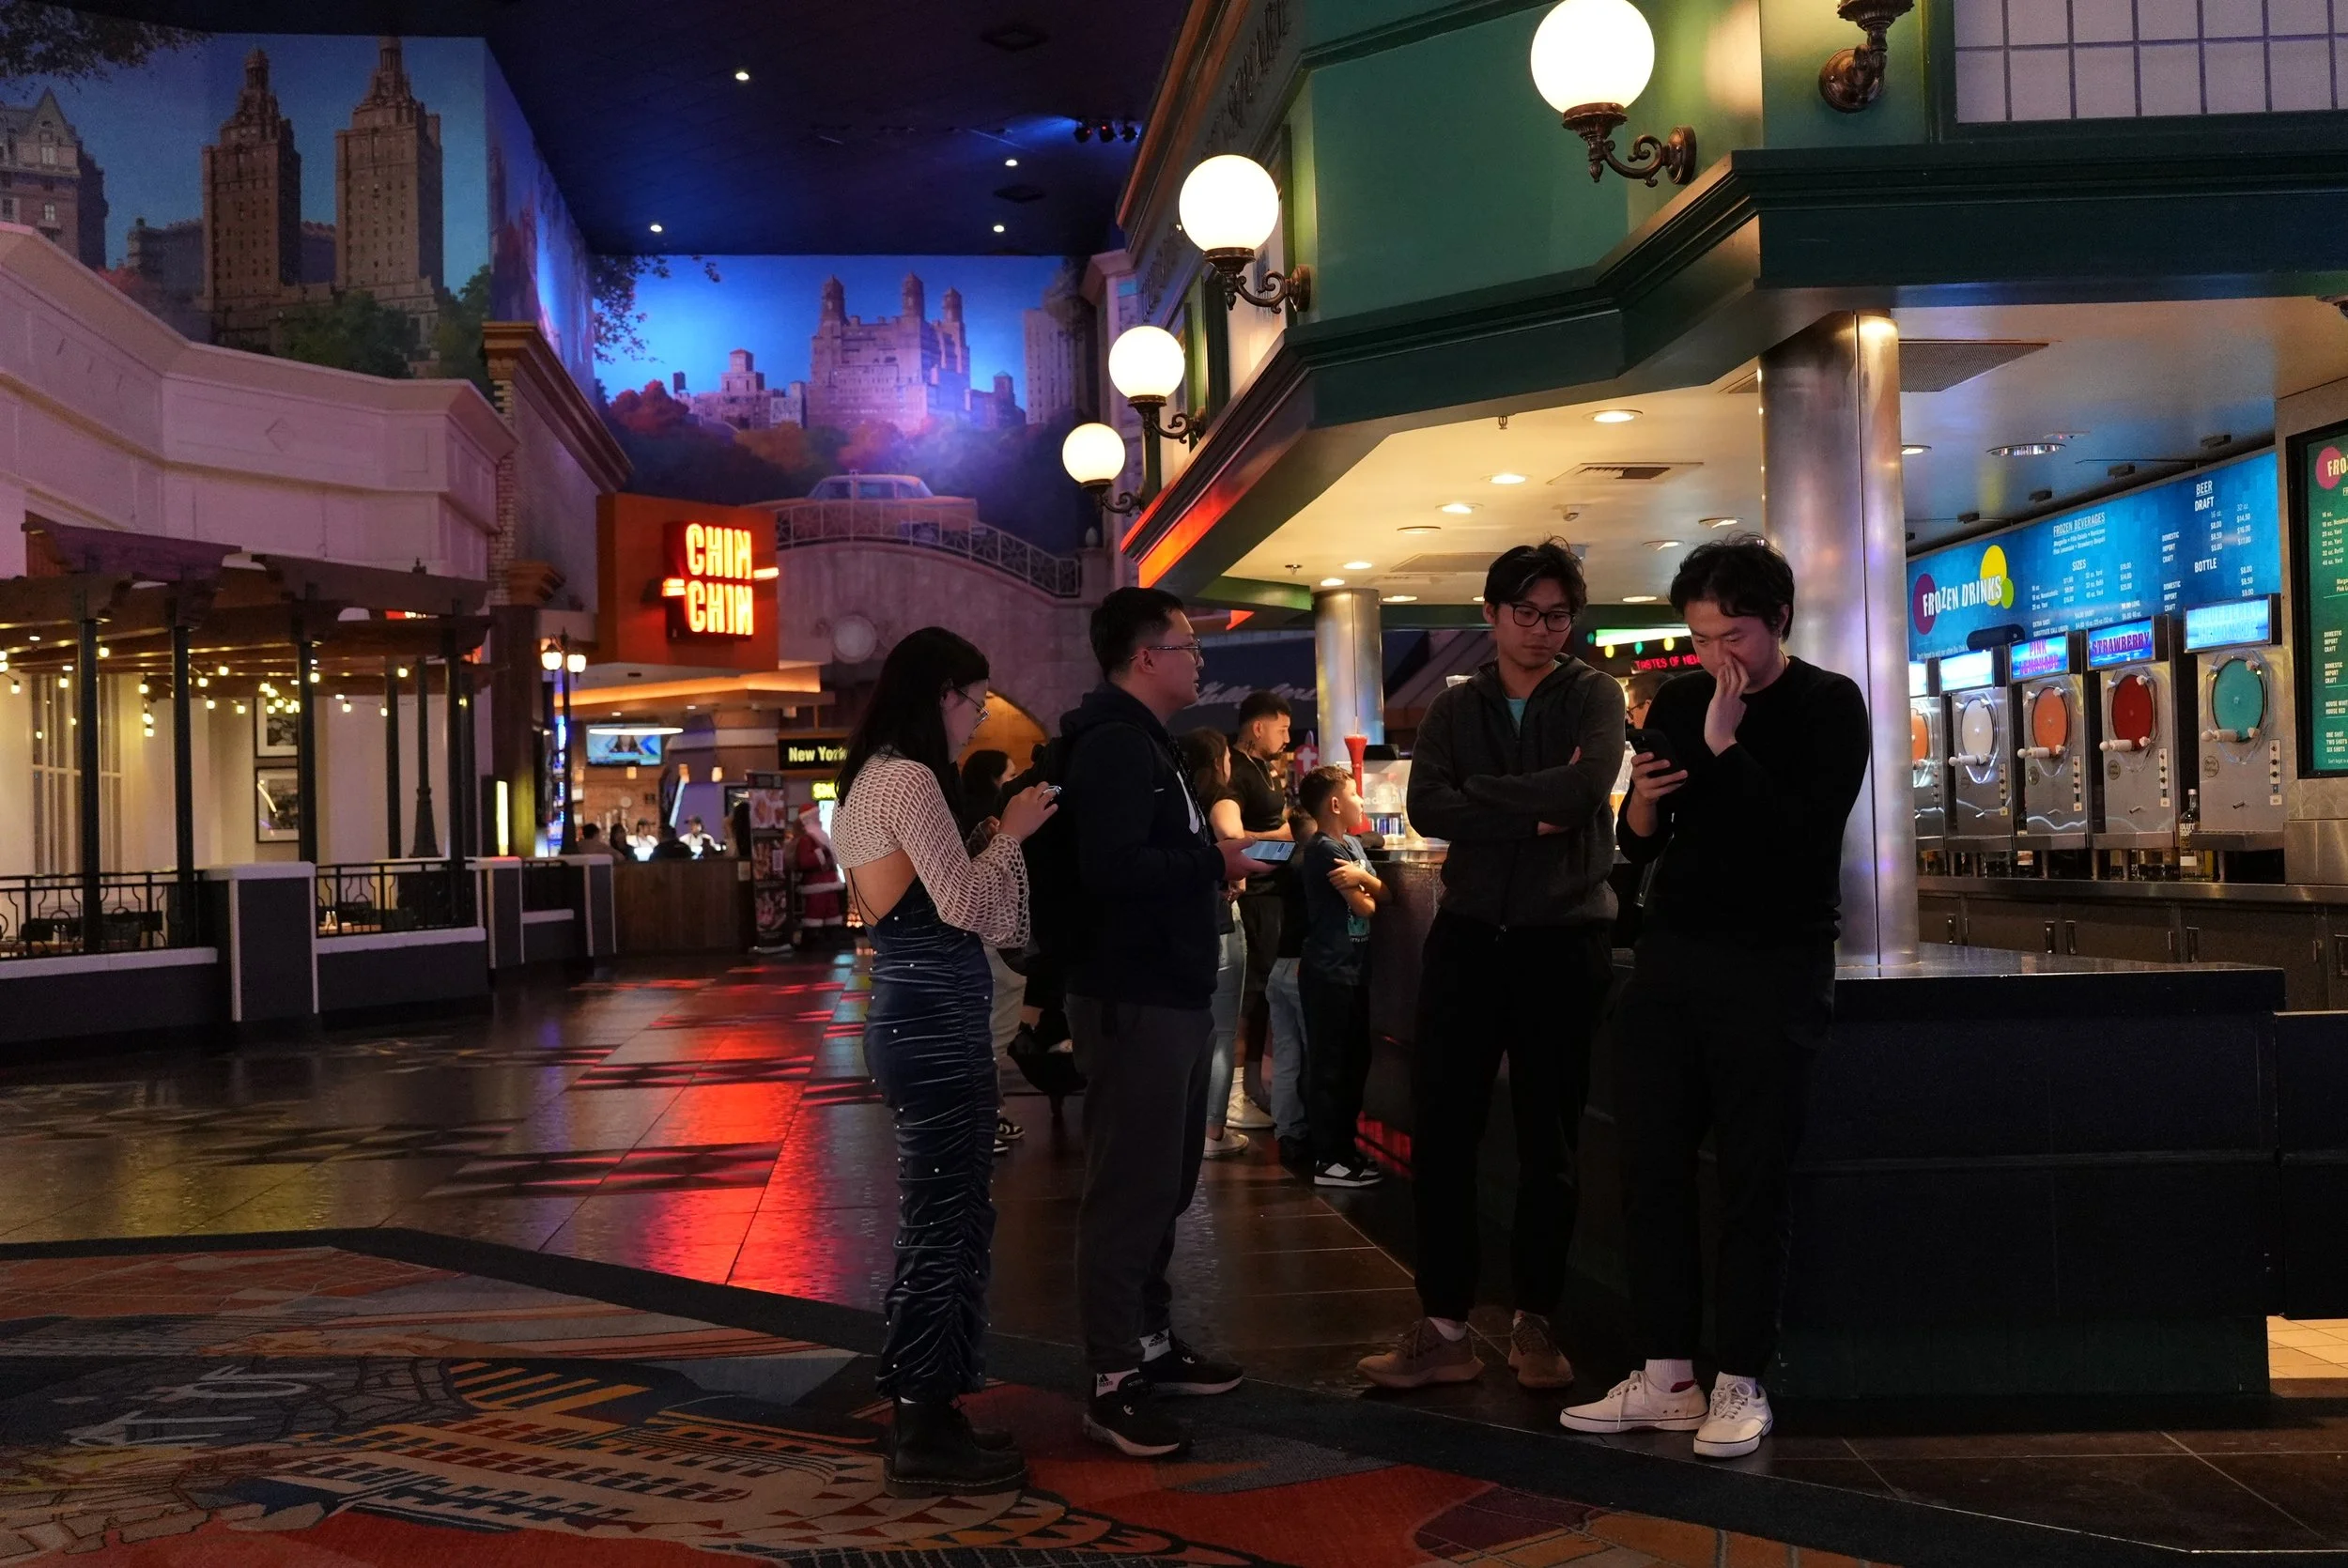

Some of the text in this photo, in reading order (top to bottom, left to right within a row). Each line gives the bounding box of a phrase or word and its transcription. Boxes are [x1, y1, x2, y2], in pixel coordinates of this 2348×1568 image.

[2196, 481, 2213, 496] BEER
[2195, 497, 2214, 512] DRAFT
[2053, 512, 2106, 536] FROZEN BEVERAGES
[2162, 531, 2179, 542] DOMESTIC
[685, 522, 752, 580] CHIN
[2163, 544, 2175, 552] IMPORT
[2072, 560, 2086, 571] SIZES
[2163, 555, 2173, 563] CRAFT
[2194, 558, 2217, 573] BOTTLE
[2163, 580, 2181, 591] DOMESTIC
[1923, 575, 2002, 618] FROZEN DRINKS
[2164, 592, 2177, 601] IMPORT
[686, 581, 754, 637] CHIN
[2165, 604, 2175, 612] CRAFT
[2324, 630, 2342, 638] DOMESTIC
[2029, 638, 2047, 656] PINK
[2092, 631, 2150, 655] STRAWBERRY
[1634, 657, 1668, 670] TASTES
[1669, 655, 1679, 667] OF
[788, 746, 815, 762] New
